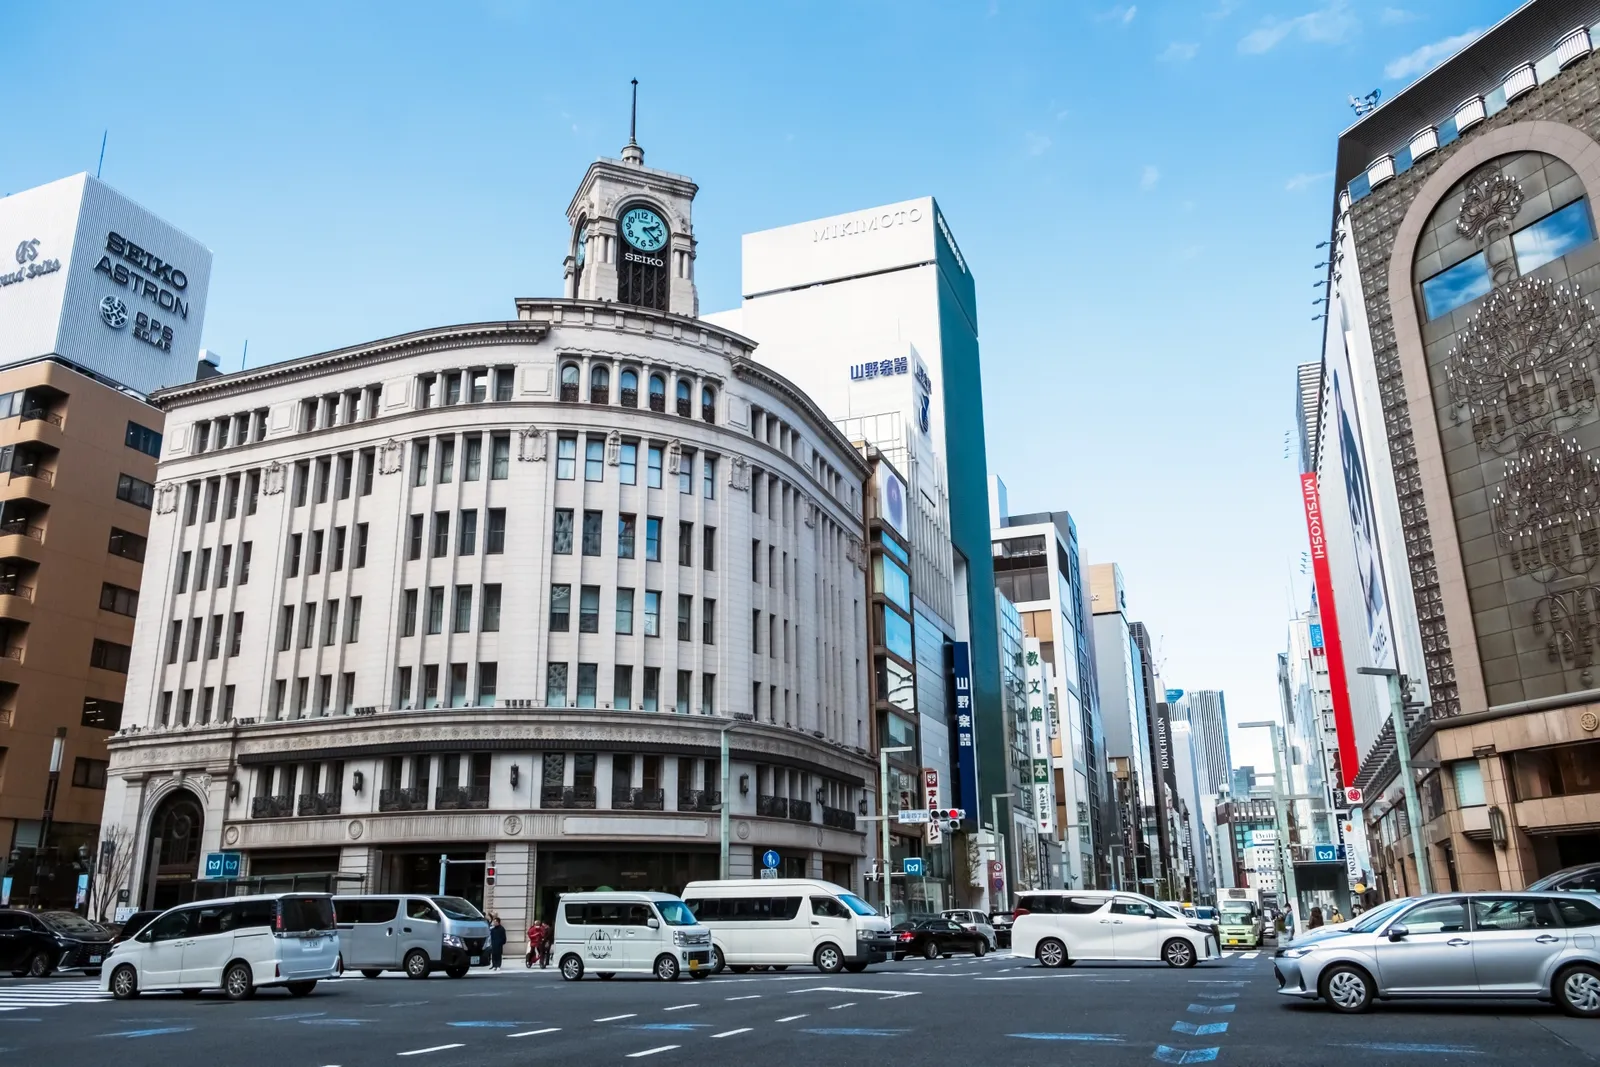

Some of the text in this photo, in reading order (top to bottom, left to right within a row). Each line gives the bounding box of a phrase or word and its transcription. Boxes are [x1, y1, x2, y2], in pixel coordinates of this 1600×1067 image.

[634, 211, 640, 219] 11
[813, 208, 923, 242] MIKIMOTO
[0, 266, 26, 287] and
[106, 231, 188, 291] SEIKO
[625, 252, 664, 267] SEIKO
[94, 255, 188, 320] ASTRON
[133, 326, 171, 353] SOLAR
[136, 311, 173, 341] GPS
[850, 356, 908, 381] 山野楽器
[1303, 478, 1325, 559] MITSUKOSHI
[1026, 650, 1043, 722] 教文館
[956, 677, 971, 747] 山野楽器
[1157, 717, 1169, 769] BOUCHERON
[1034, 762, 1047, 779] 本
[928, 789, 939, 841] キムラパン
